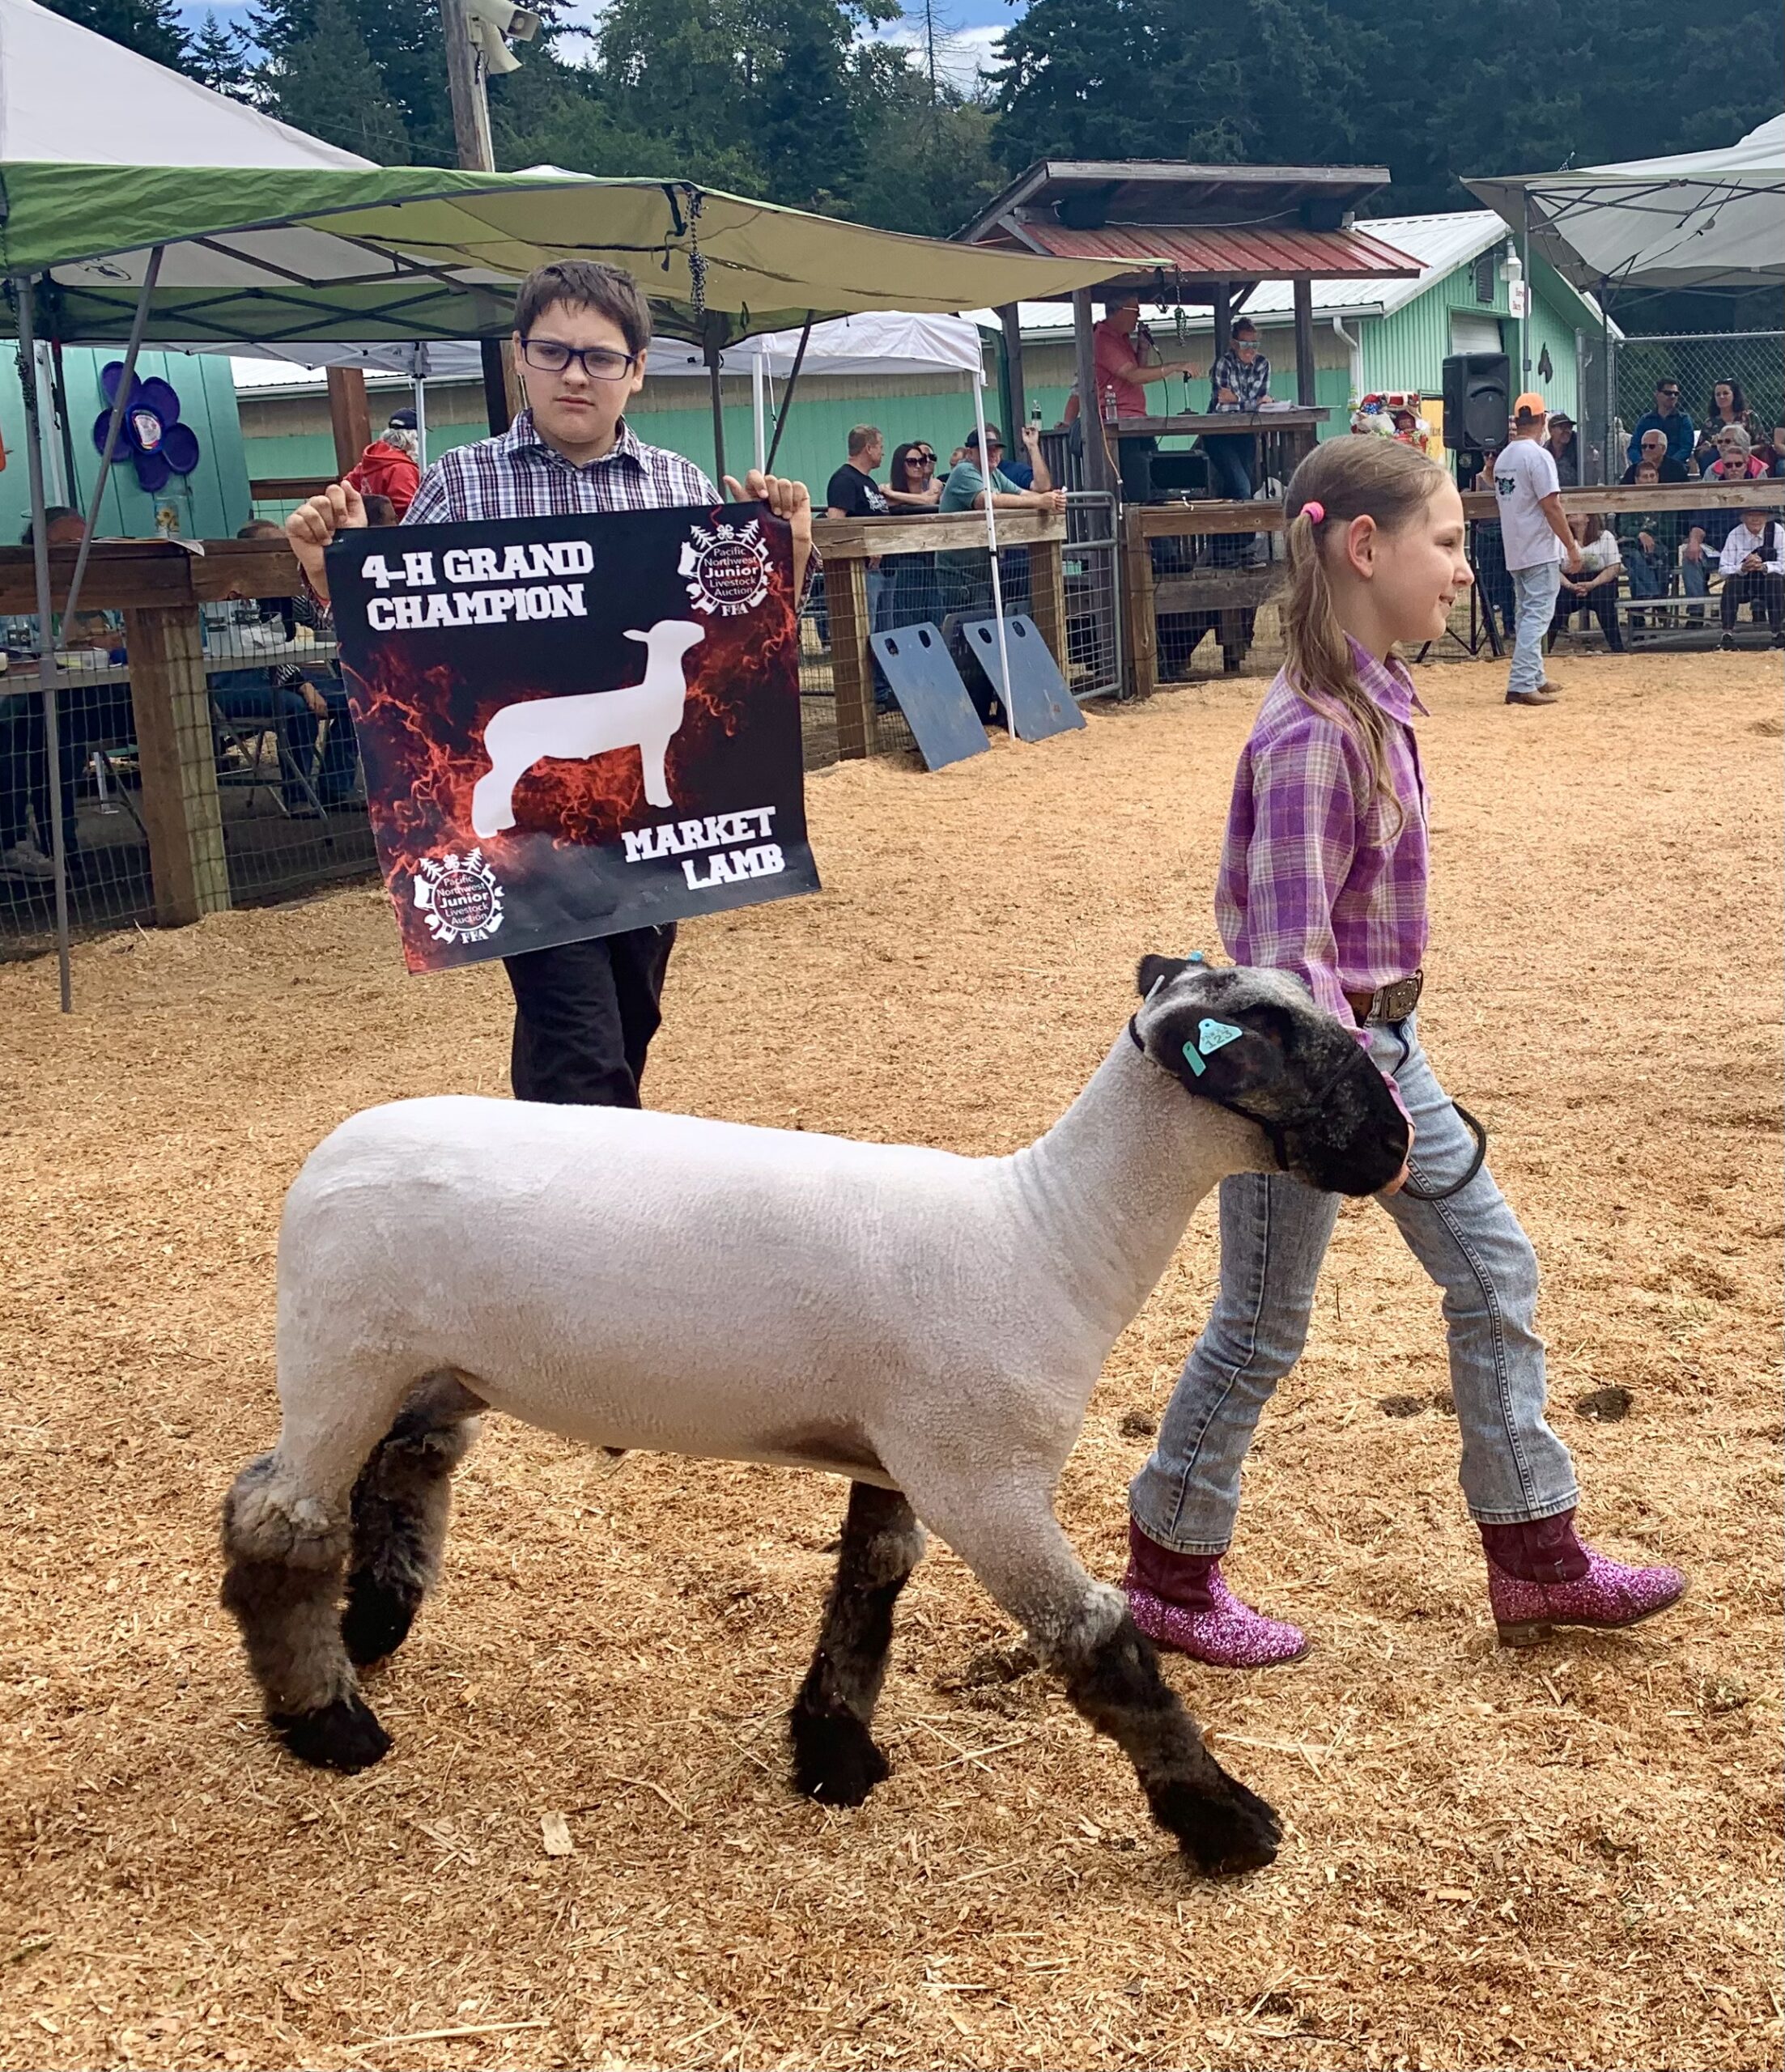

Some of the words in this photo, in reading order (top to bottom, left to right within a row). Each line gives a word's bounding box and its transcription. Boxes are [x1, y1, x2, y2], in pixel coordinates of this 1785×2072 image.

[713, 546, 746, 557] Pacific
[362, 552, 436, 588] 4-H
[443, 541, 594, 583] GRAND
[703, 556, 758, 567] Northwest
[704, 565, 759, 579] Junior
[709, 575, 756, 588] Livestock
[714, 586, 753, 597] Auction
[367, 584, 588, 631] CHAMPION
[721, 603, 749, 617] FFA
[621, 806, 776, 863] MARKET
[682, 843, 785, 890] LAMB
[443, 875, 474, 886] Pacific
[437, 882, 486, 898] Northwest
[440, 892, 489, 908] Junior
[445, 902, 489, 918] Livestock
[451, 912, 487, 925] Auction
[461, 928, 489, 944] FFA
[1205, 1030, 1233, 1049] 123
